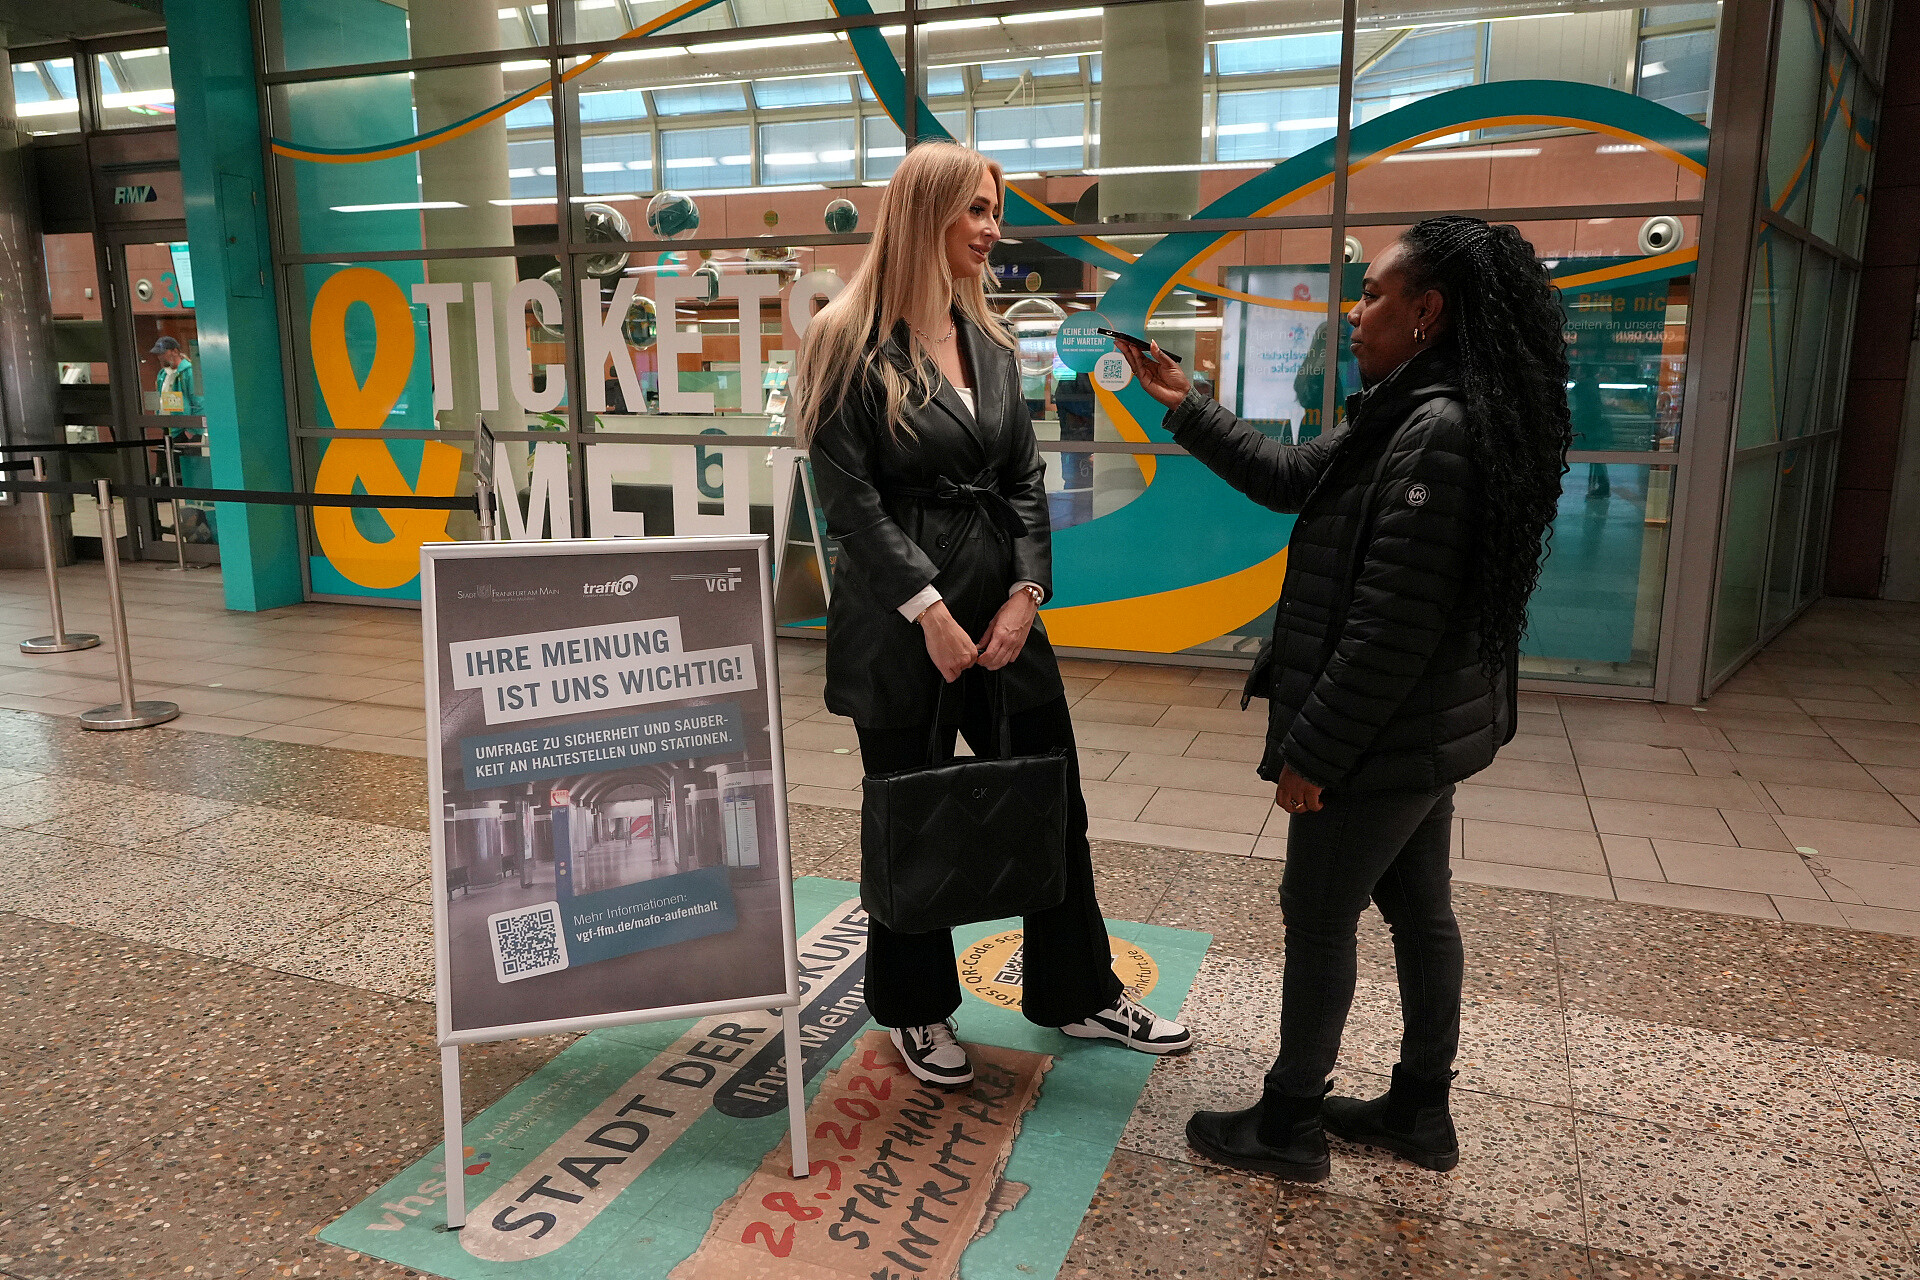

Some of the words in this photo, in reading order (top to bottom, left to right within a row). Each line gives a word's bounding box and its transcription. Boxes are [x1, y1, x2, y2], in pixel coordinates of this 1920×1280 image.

[115, 186, 151, 204] RMV
[161, 271, 179, 308] 3
[1577, 293, 1626, 312] Bitte
[1062, 328, 1081, 336] KEINE
[1606, 322, 1620, 330] an
[488, 440, 808, 540] MEH
[539, 587, 560, 595] MAIN
[466, 646, 532, 677] IHRE
[541, 629, 670, 668] MEINUNG
[497, 682, 541, 712] IST
[551, 674, 610, 705] UNS
[618, 656, 743, 695] WICHTIG!
[475, 740, 539, 760] UMFRAGE
[543, 736, 560, 751] ZU
[564, 725, 639, 748] SICHERHEIT
[643, 721, 671, 737] UND
[674, 714, 728, 732] SAUBER-
[475, 762, 504, 778] KEIT
[509, 759, 528, 774] AN
[532, 745, 627, 771] HALTESTELLEN
[630, 741, 658, 757] UND
[661, 731, 733, 752] STATIONEN.
[573, 911, 603, 926] Mehr
[607, 894, 688, 919] Informationen:
[576, 900, 719, 943] vgf-ffm.de/mafo-aufenthalt
[961, 943, 995, 984] QR-Code
[995, 932, 1023, 945] sca
[1127, 950, 1152, 996] nkfurt.de
[800, 975, 866, 1048] Meinu
[479, 1068, 580, 1141] Volkshochschule
[492, 1093, 677, 1240] STADT
[657, 1022, 768, 1090] DER
[829, 1089, 945, 1250] STADTHAU
[365, 1178, 448, 1232] vhs
